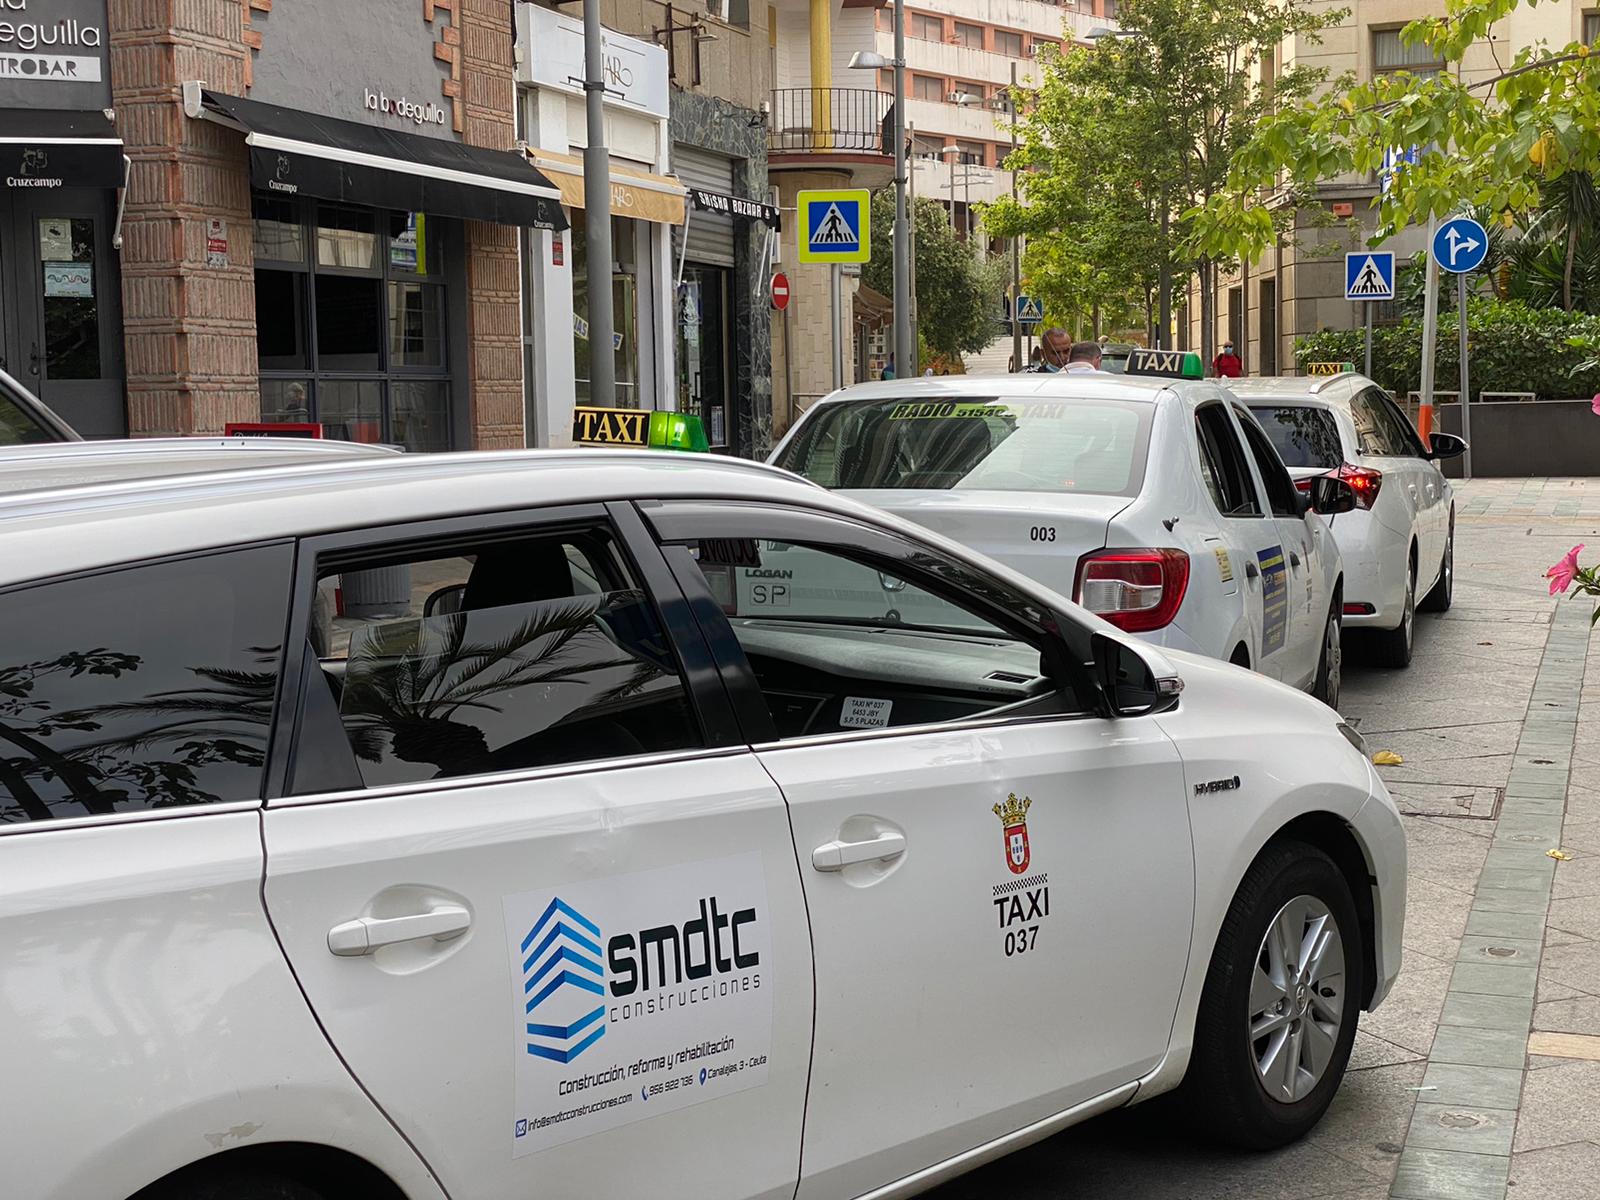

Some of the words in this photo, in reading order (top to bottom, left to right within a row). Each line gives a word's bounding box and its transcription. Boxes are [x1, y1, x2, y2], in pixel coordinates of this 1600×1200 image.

[0, 19, 100, 49] eguilla
[364, 88, 378, 110] la
[380, 91, 445, 124] bodeguilla
[7, 176, 63, 188] Cruzcampo
[732, 200, 762, 218] BAZAAR
[1135, 352, 1181, 372] TAXI
[1309, 363, 1341, 375] TAXI
[891, 401, 956, 419] RADIO
[578, 411, 646, 444] TAXI
[1030, 526, 1056, 542] 003
[745, 568, 793, 579] LOGAN
[1193, 778, 1234, 797] HYBRID
[993, 887, 1050, 929] TAXI
[607, 896, 760, 998] smdtc
[1004, 926, 1040, 957] 037
[610, 974, 761, 1023] construcciones
[559, 1064, 626, 1096] Construcción,
[627, 1056, 666, 1078] reforma
[667, 1054, 674, 1070] y
[675, 1035, 734, 1064] rehabilitación
[749, 1055, 767, 1068] Ceuta
[649, 1083, 664, 1096] 956
[665, 1078, 679, 1092] 922
